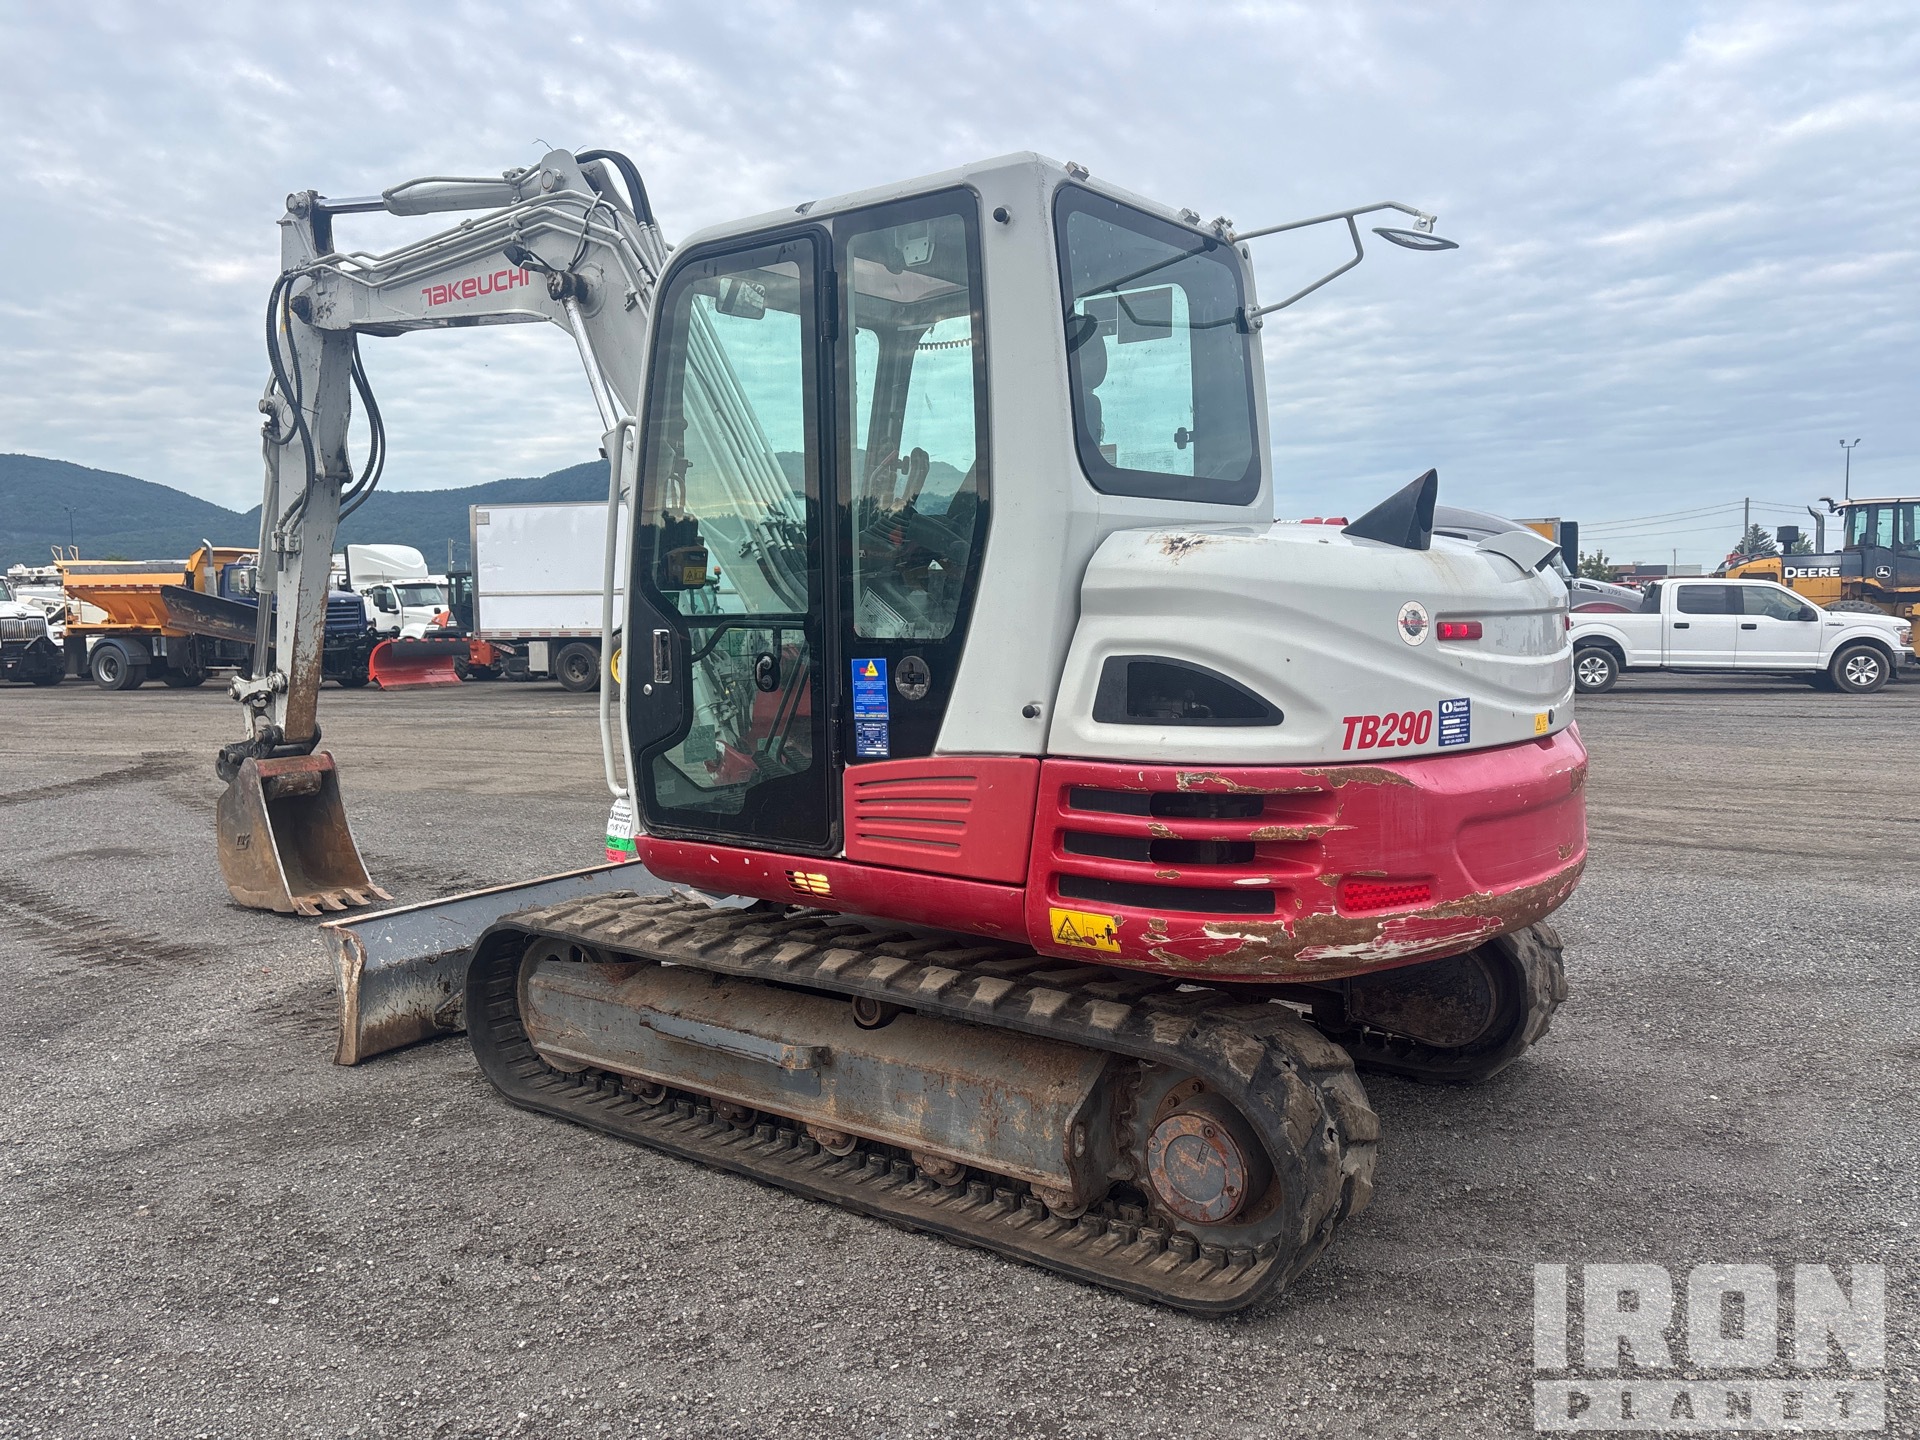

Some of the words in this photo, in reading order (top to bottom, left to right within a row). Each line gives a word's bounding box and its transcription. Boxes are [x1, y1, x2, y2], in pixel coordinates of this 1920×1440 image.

[422, 268, 530, 307] TAKEUCHI
[1784, 567, 1840, 579] DEERE
[1607, 588, 1622, 596] 1795
[1342, 709, 1433, 751] TB290
